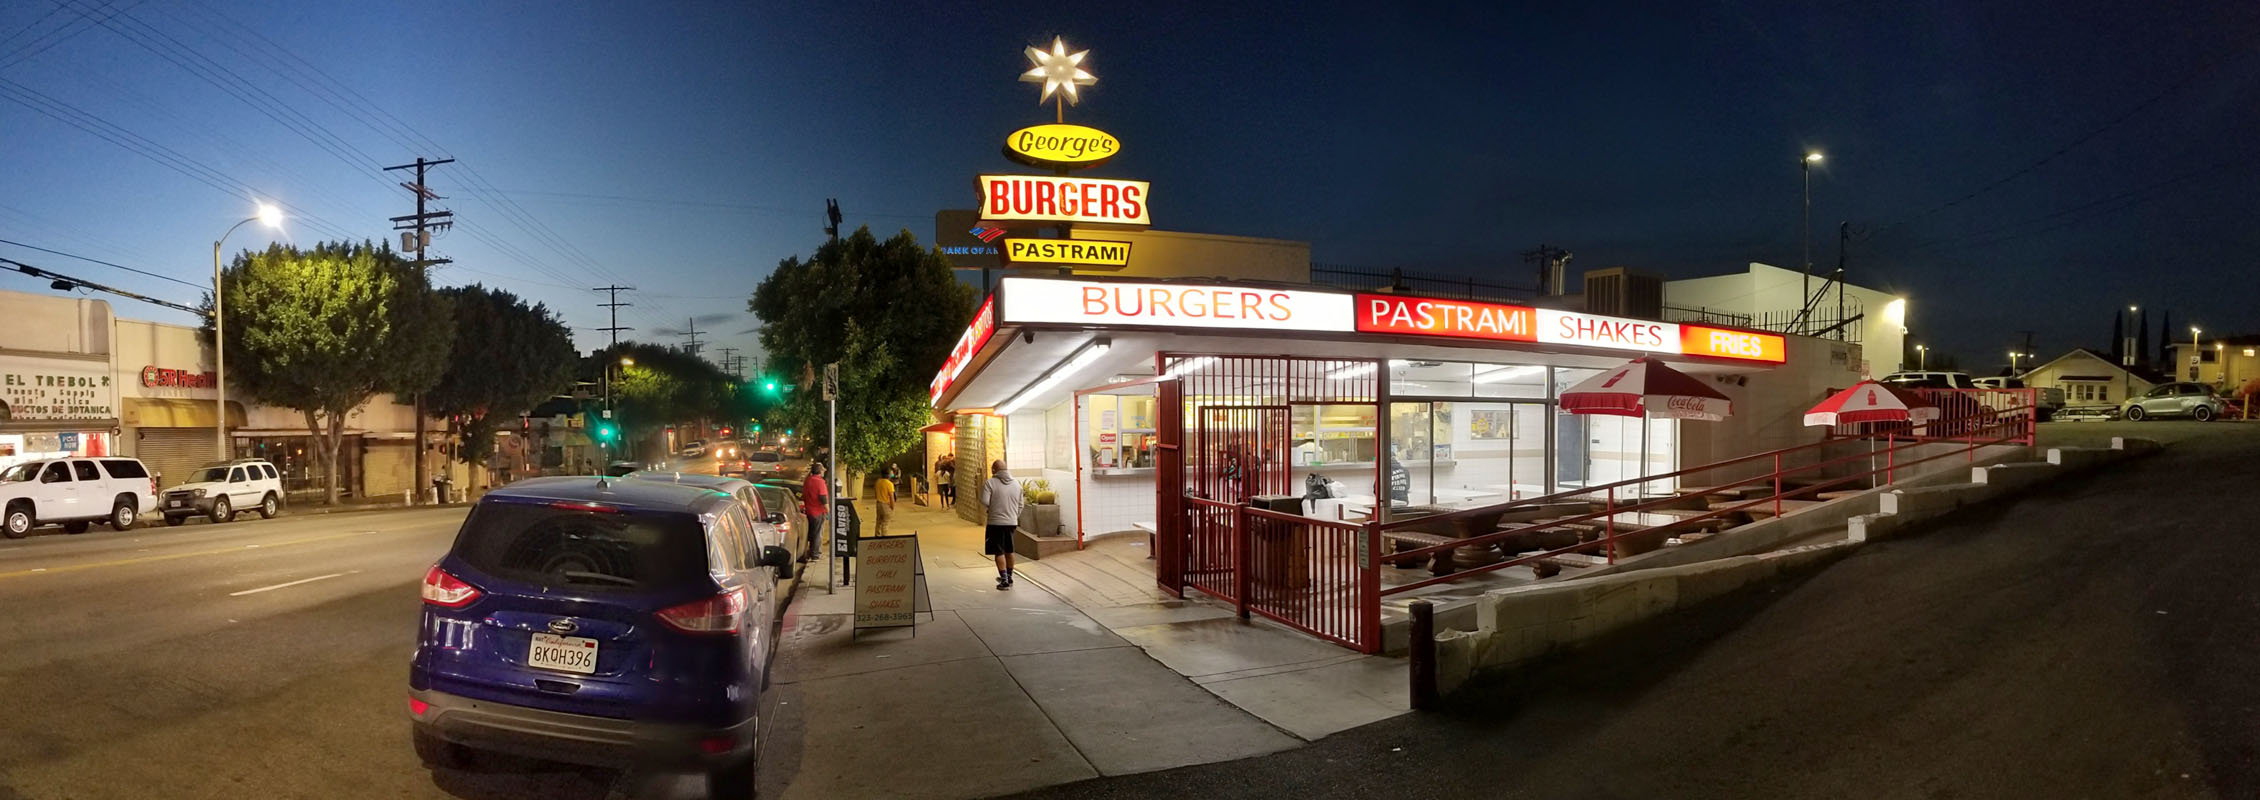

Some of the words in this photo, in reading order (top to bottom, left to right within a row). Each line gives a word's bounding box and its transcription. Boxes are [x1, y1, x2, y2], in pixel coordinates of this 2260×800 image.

[1018, 131, 1113, 158] George's
[990, 180, 1142, 219] BURGERS
[970, 246, 984, 255] OF
[1012, 242, 1125, 261] PASTRAMI
[1082, 286, 1292, 321] BURGERS
[1371, 299, 1527, 336] PASTRAMI
[1559, 315, 1663, 347] SHAKES
[1709, 332, 1762, 358] FRIES
[5, 374, 26, 386] EL
[35, 375, 97, 388] TREBOL
[52, 405, 64, 414] DE
[68, 406, 111, 415] BOTANICA
[867, 540, 907, 551] BURGERS
[866, 554, 908, 566] BURRITOS
[876, 569, 897, 579] CHILI
[865, 584, 907, 594] PASTRAMI
[869, 600, 902, 609] SHAKES
